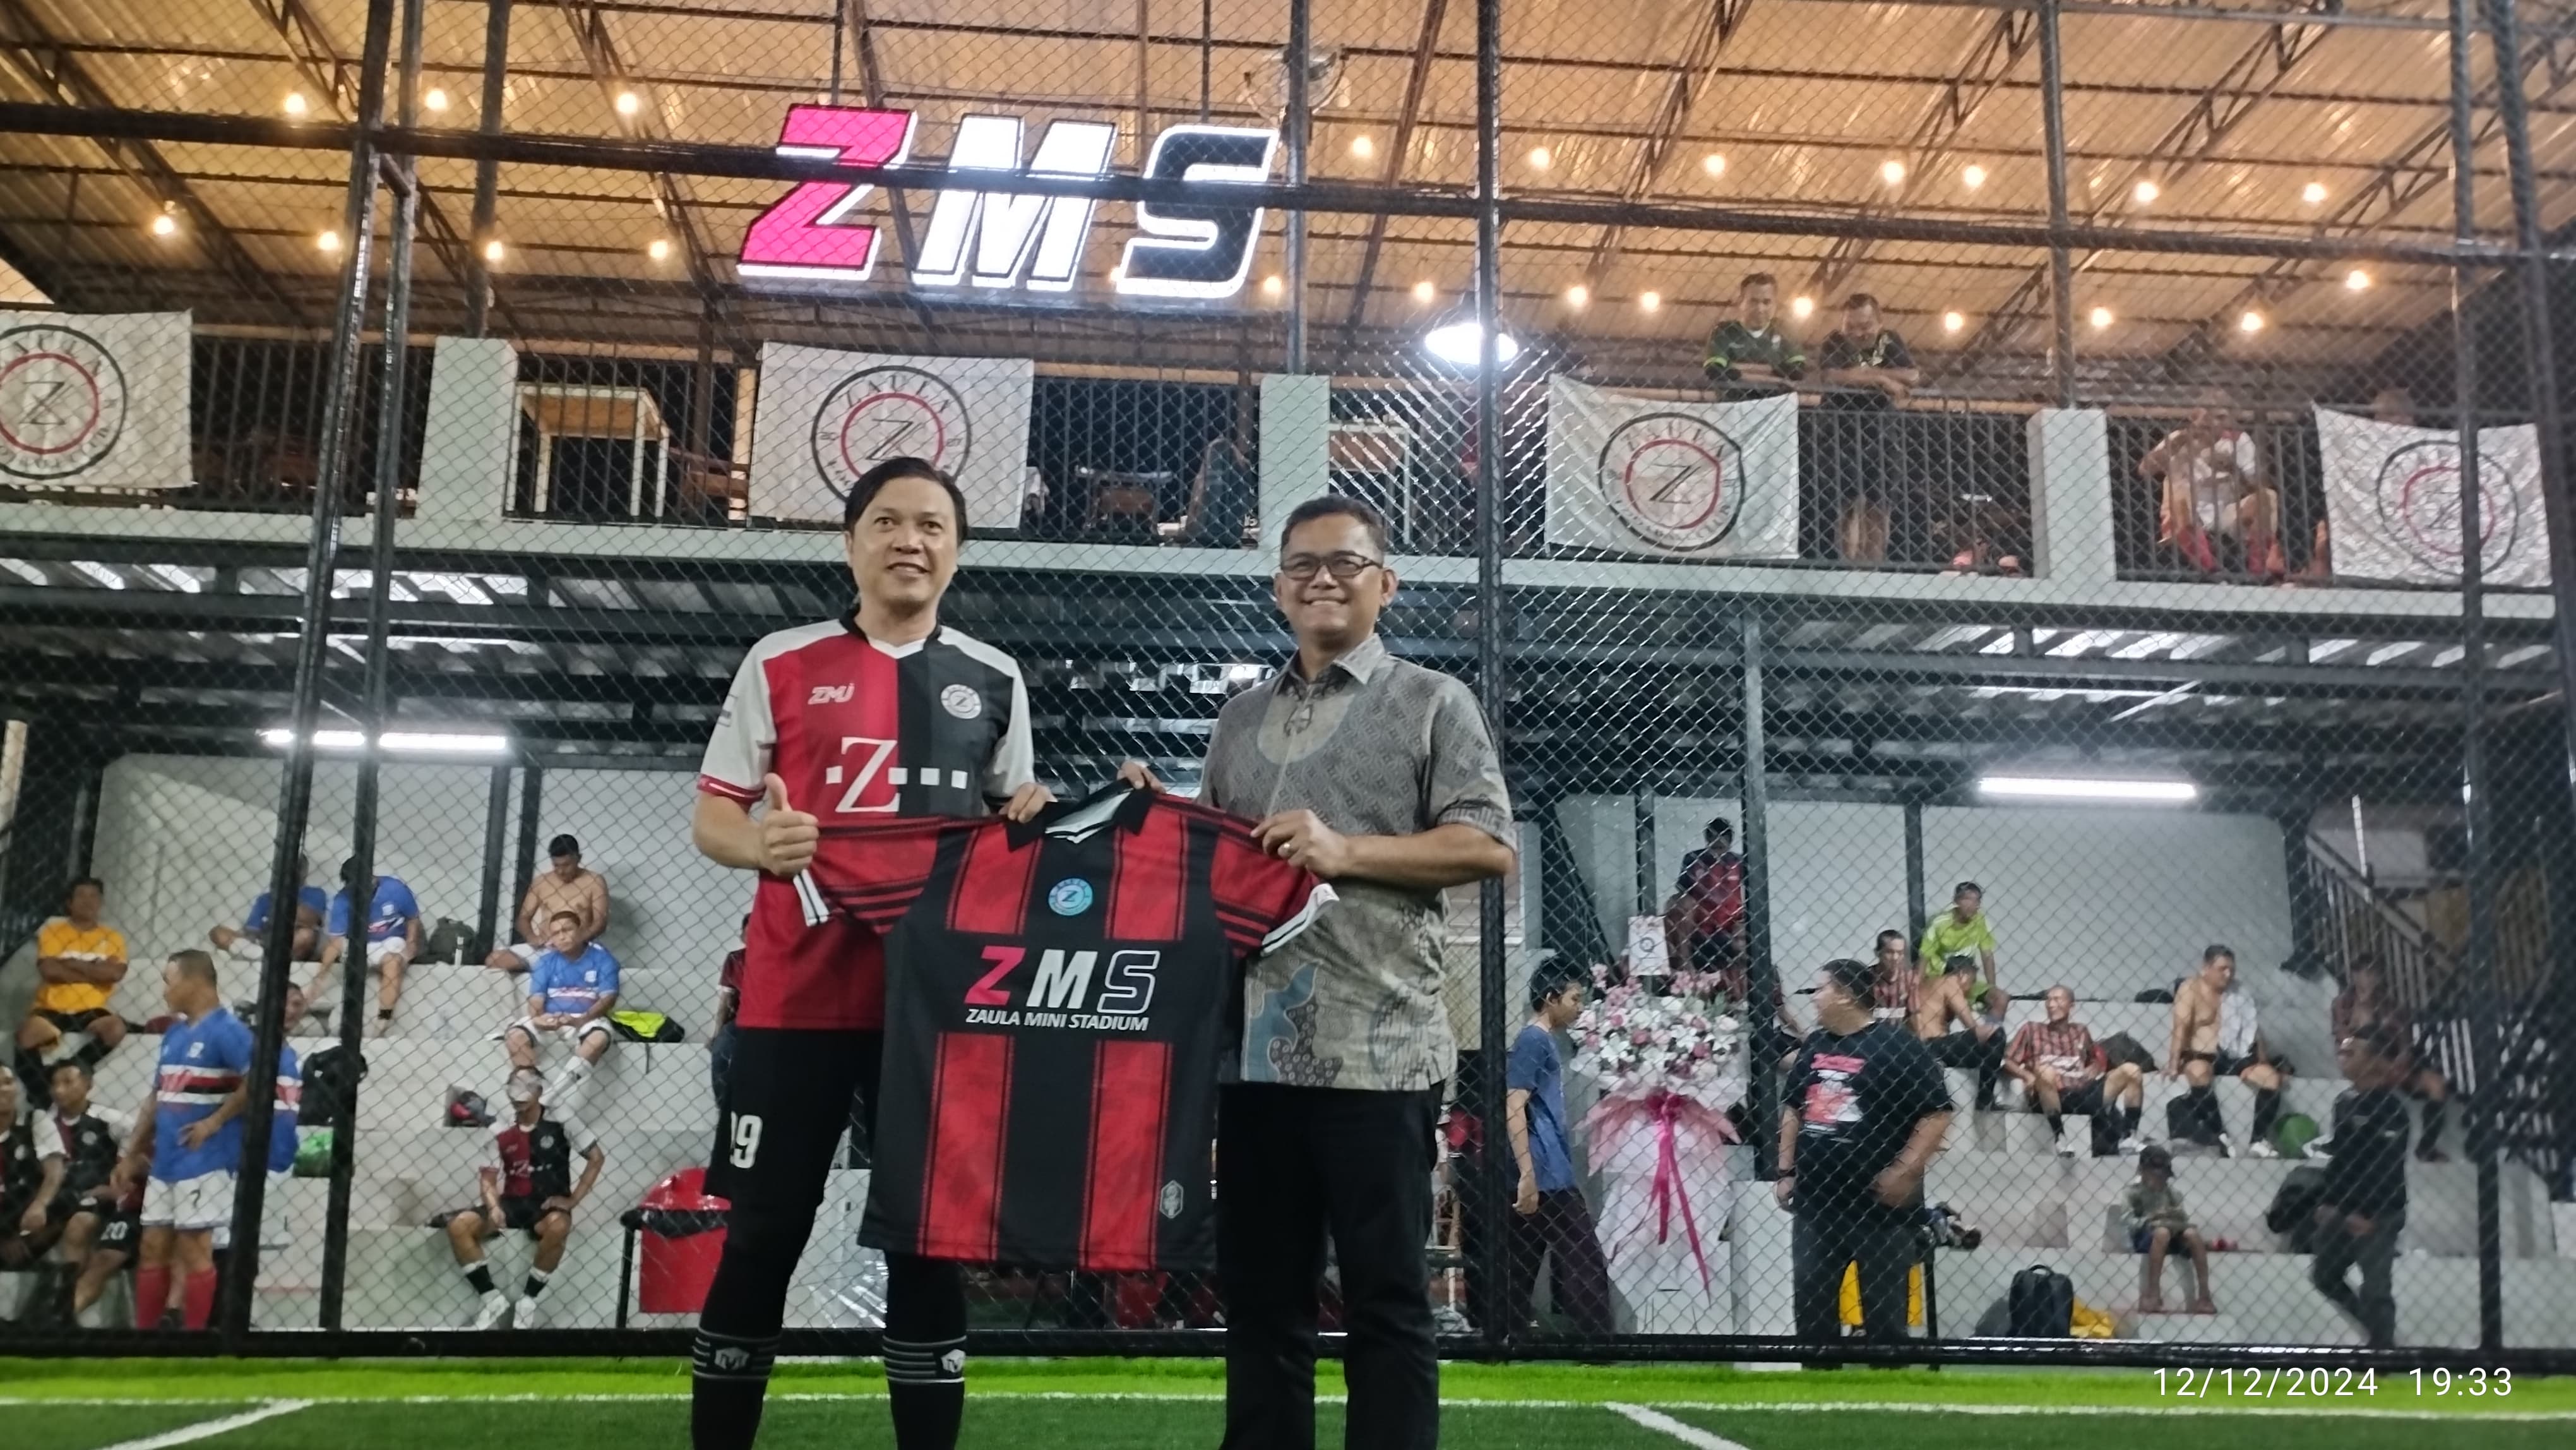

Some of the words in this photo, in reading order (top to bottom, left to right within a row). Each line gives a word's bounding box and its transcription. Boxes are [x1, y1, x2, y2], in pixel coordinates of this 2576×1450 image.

[736, 103, 1280, 299] ZMS
[838, 374, 950, 414] ZAULA
[835, 736, 901, 813] Z
[964, 945, 1160, 1014] ZMS
[965, 1009, 1020, 1026] ZAULA
[1024, 1012, 1067, 1028] MINI
[1068, 1014, 1149, 1031] STADIUM
